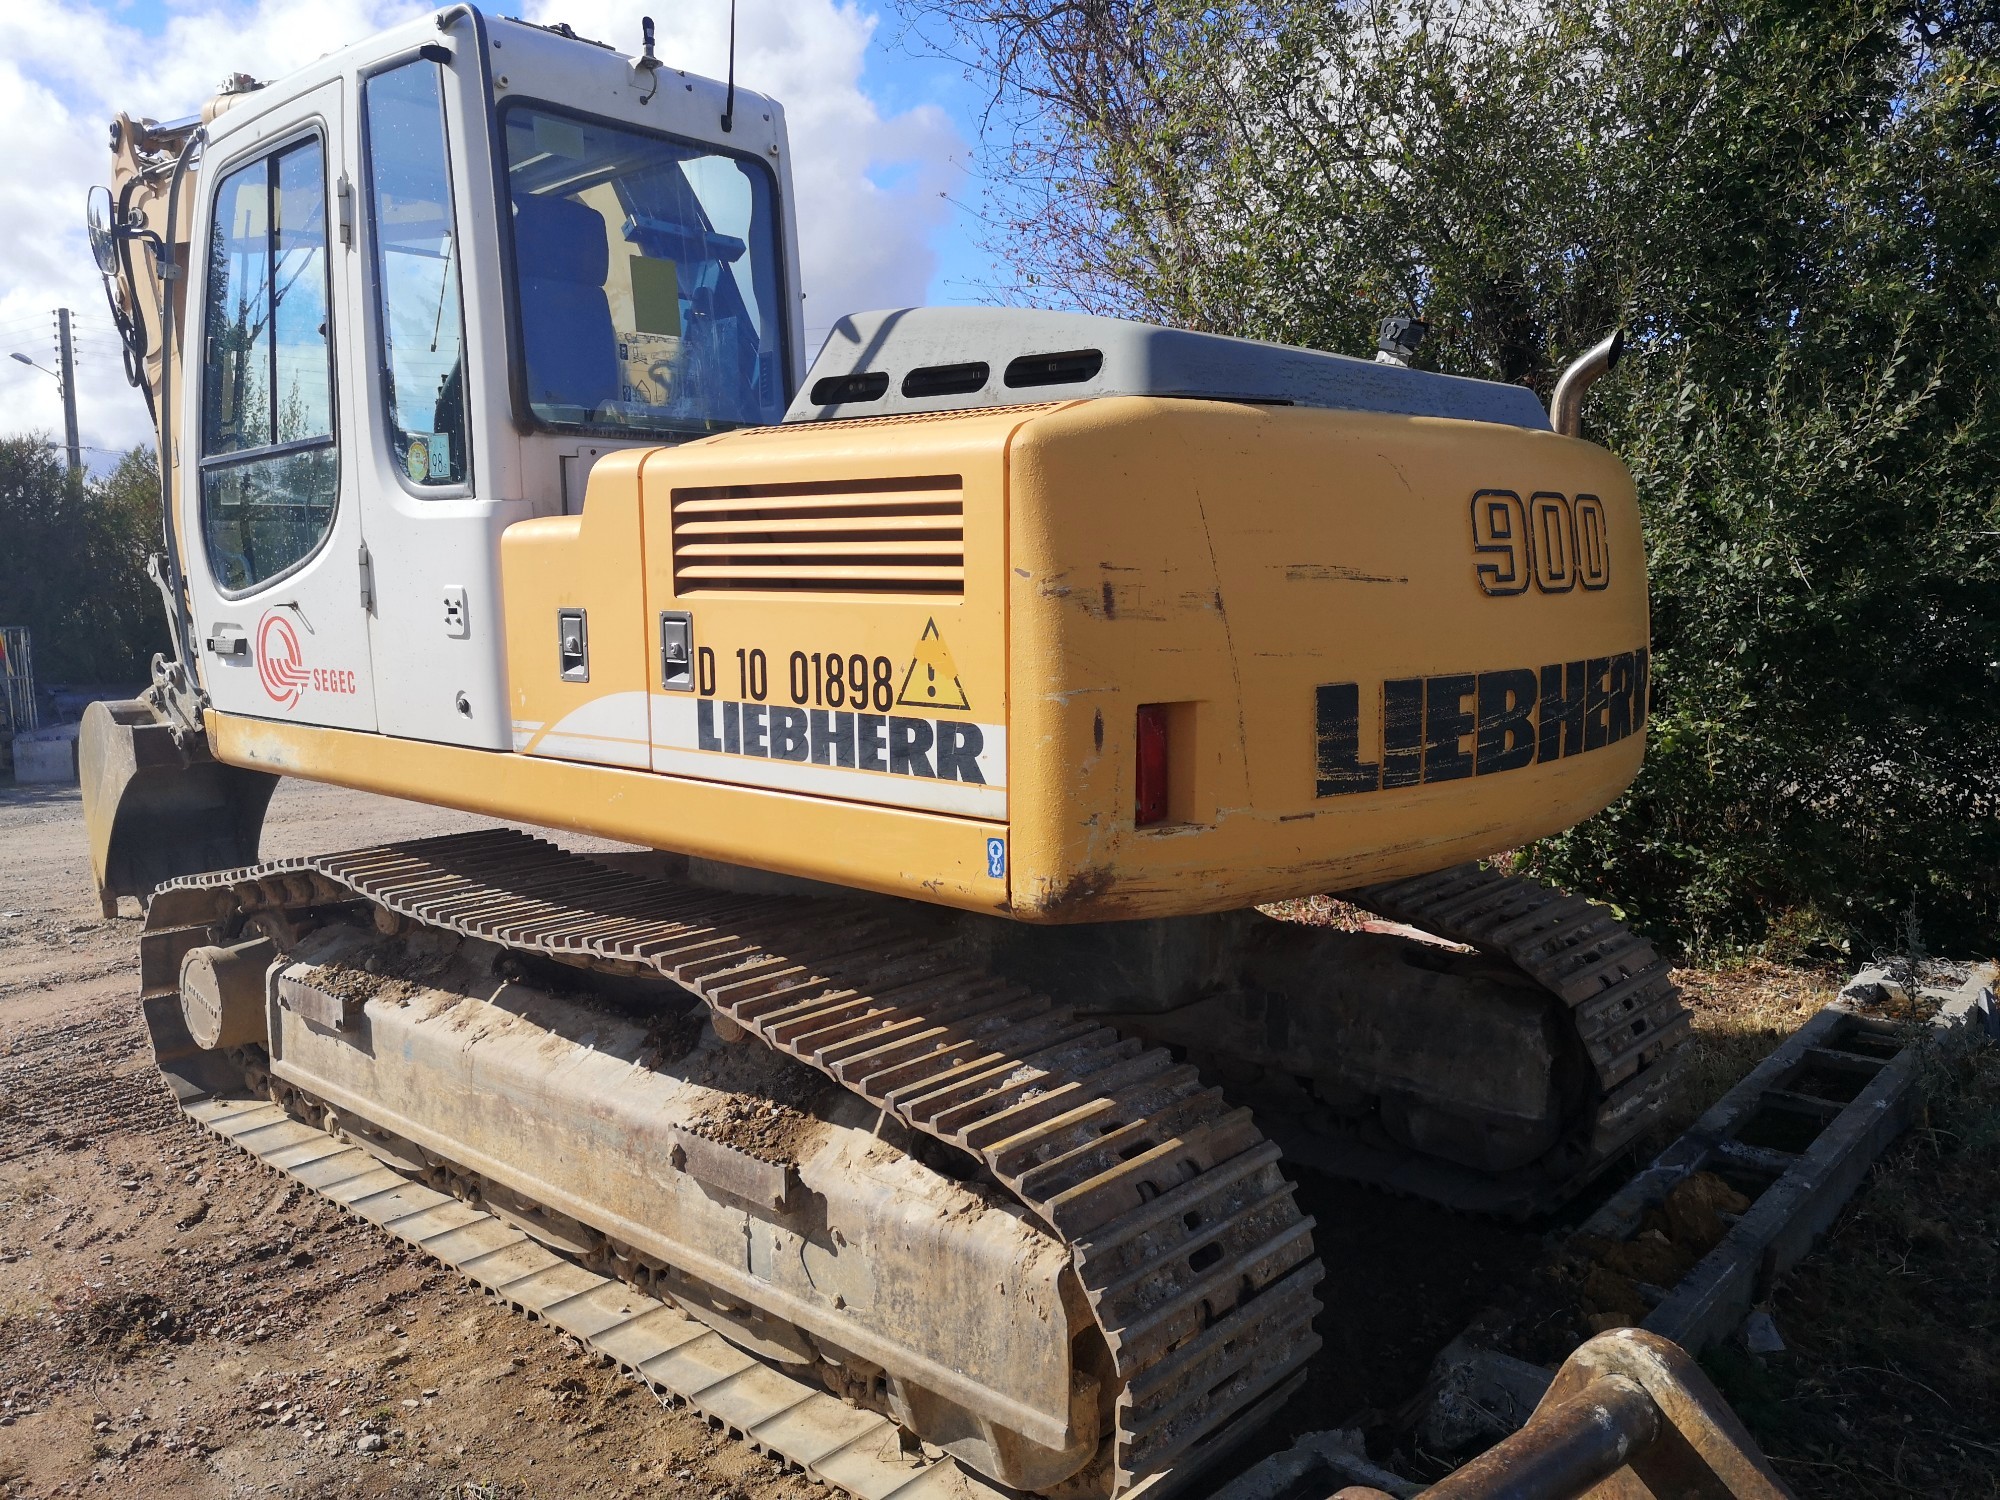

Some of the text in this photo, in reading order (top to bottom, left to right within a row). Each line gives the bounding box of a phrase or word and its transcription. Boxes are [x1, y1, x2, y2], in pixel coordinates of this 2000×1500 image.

[1471, 489, 1609, 596] 900
[313, 668, 356, 694] SEGEC
[699, 646, 893, 712] D 10 01898
[697, 698, 987, 785] LIEBHERR
